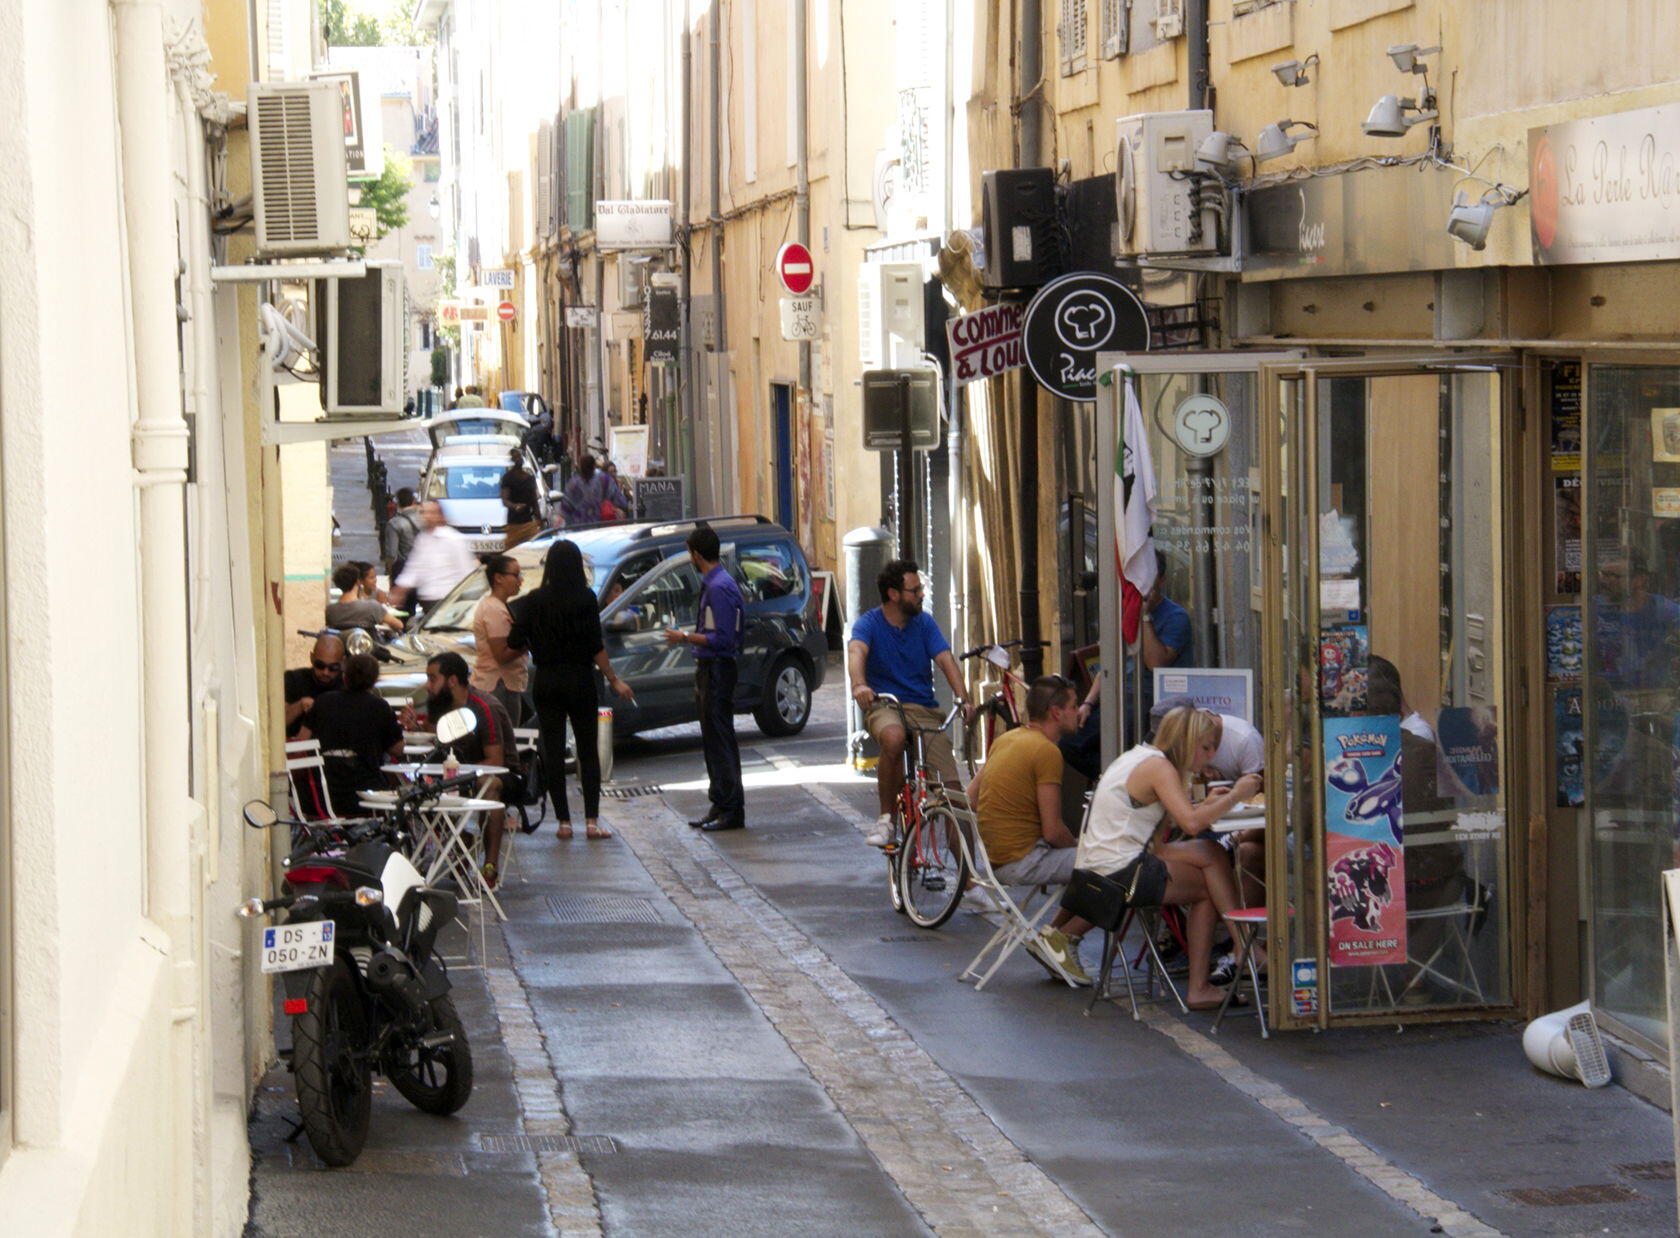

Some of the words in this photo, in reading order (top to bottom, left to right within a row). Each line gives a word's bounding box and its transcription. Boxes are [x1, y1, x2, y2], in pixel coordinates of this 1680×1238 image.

[483, 271, 512, 286] LAVERIE
[792, 301, 812, 312] SAUF
[283, 929, 303, 944] DS
[1338, 941, 1351, 950] ON
[1352, 940, 1374, 950] SALE
[1376, 939, 1398, 949] HERE
